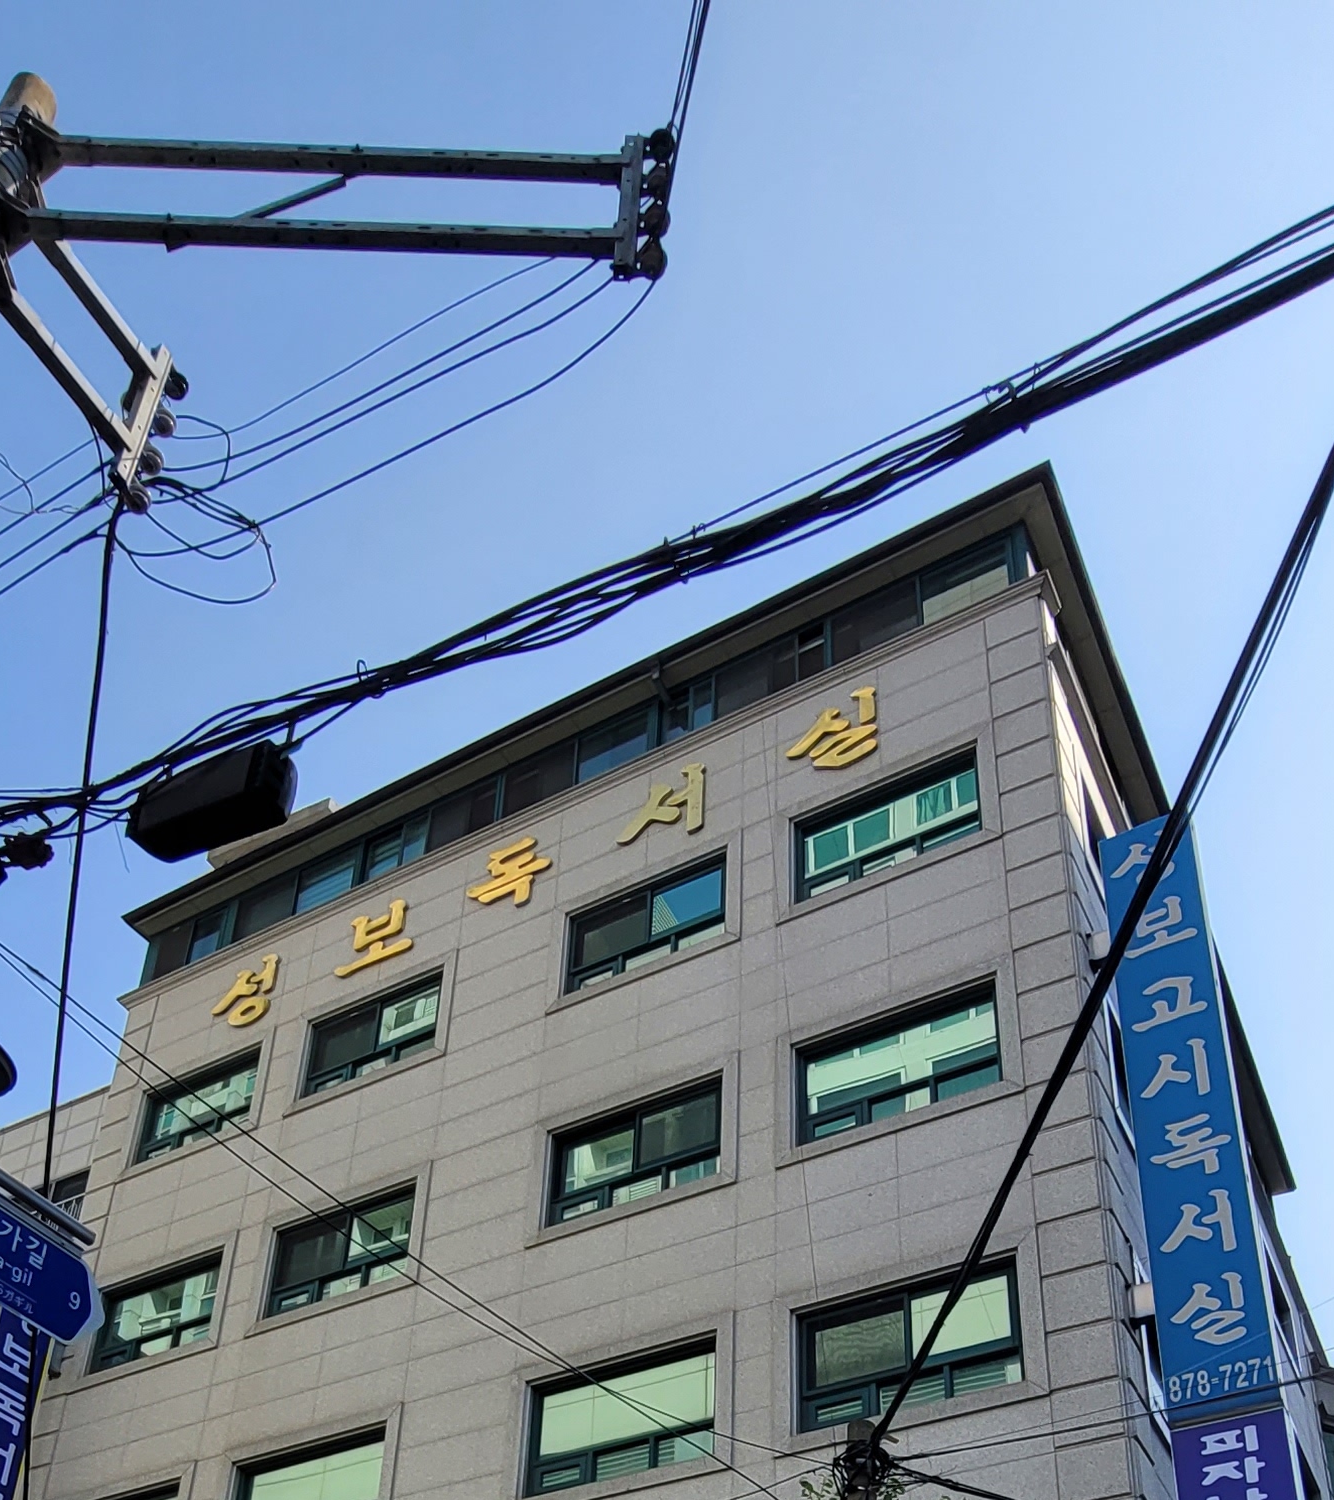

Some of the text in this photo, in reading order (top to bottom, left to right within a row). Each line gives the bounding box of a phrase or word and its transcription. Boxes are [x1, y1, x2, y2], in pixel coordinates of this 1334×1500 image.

[211, 685, 879, 1028] 성보독서실
[67, 1291, 81, 1311] 9
[1168, 1354, 1276, 1404] 878-7271
